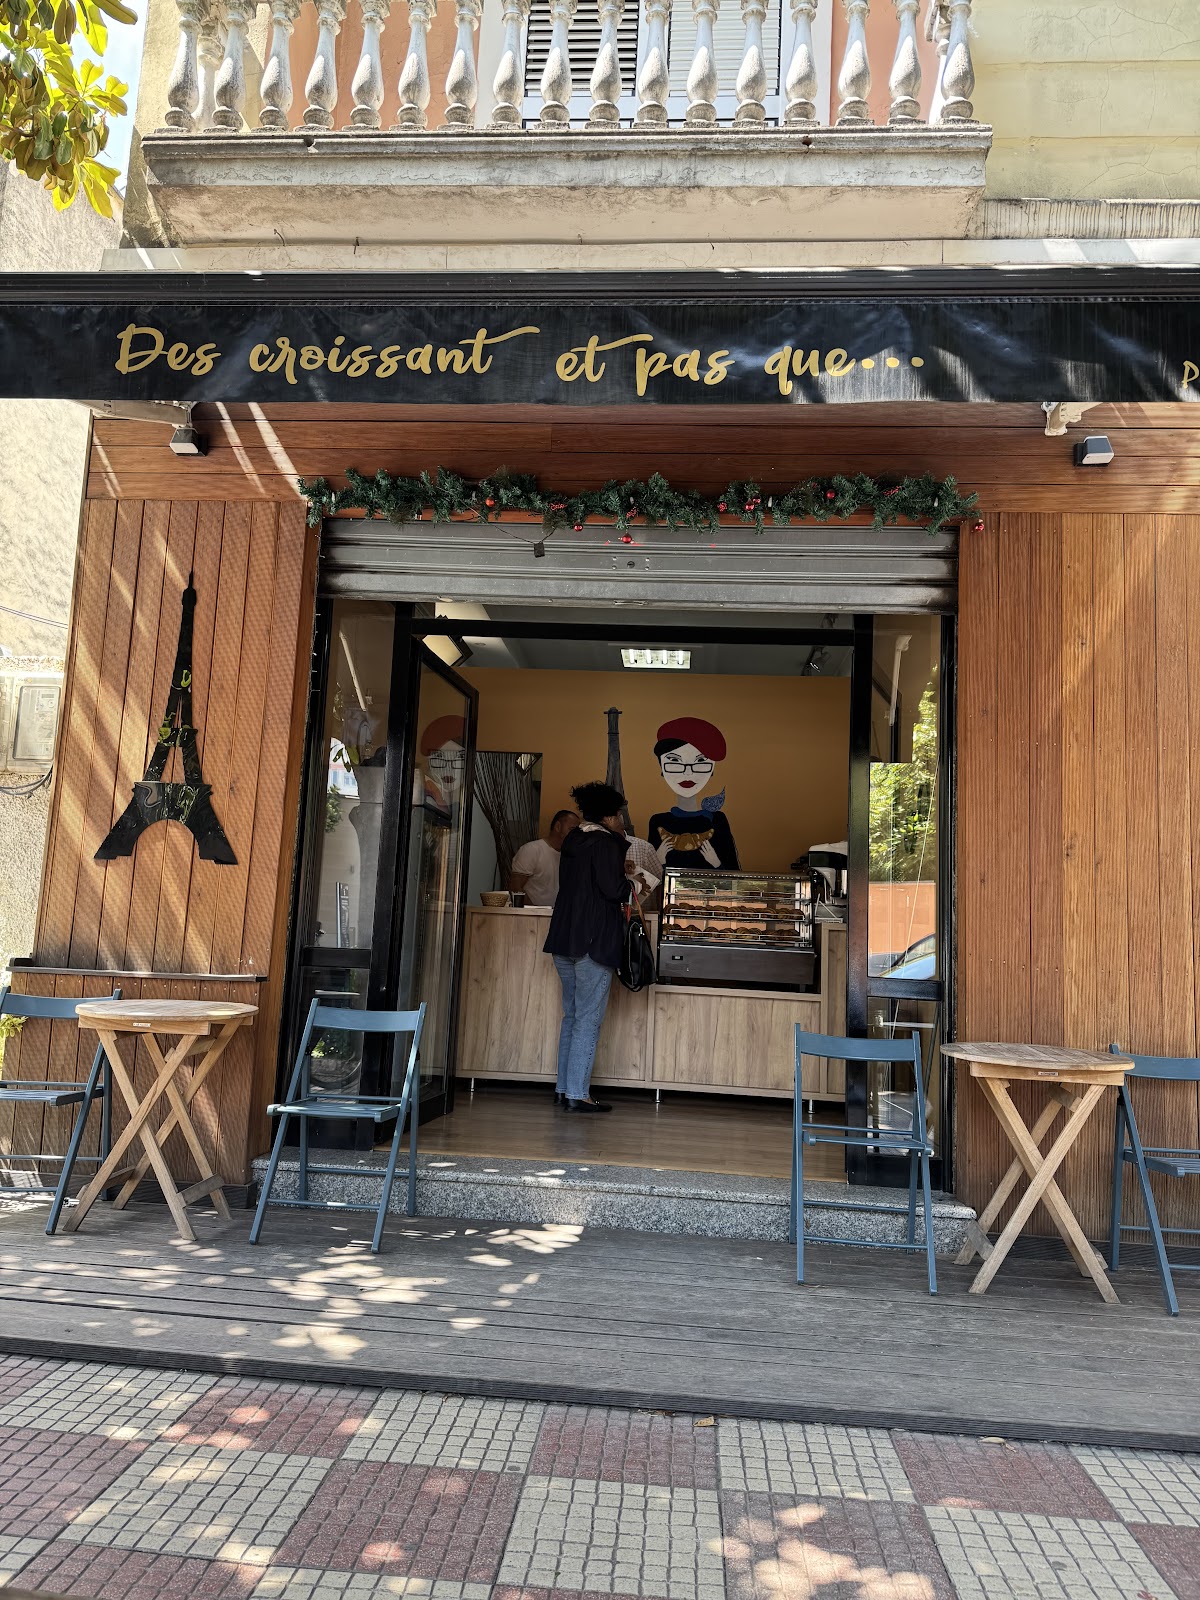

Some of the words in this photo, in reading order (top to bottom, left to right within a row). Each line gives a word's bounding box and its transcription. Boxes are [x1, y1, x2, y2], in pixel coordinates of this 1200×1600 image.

[114, 323, 222, 376] Des
[249, 325, 540, 385] croissant
[555, 333, 654, 383] et
[636, 347, 735, 397] pas
